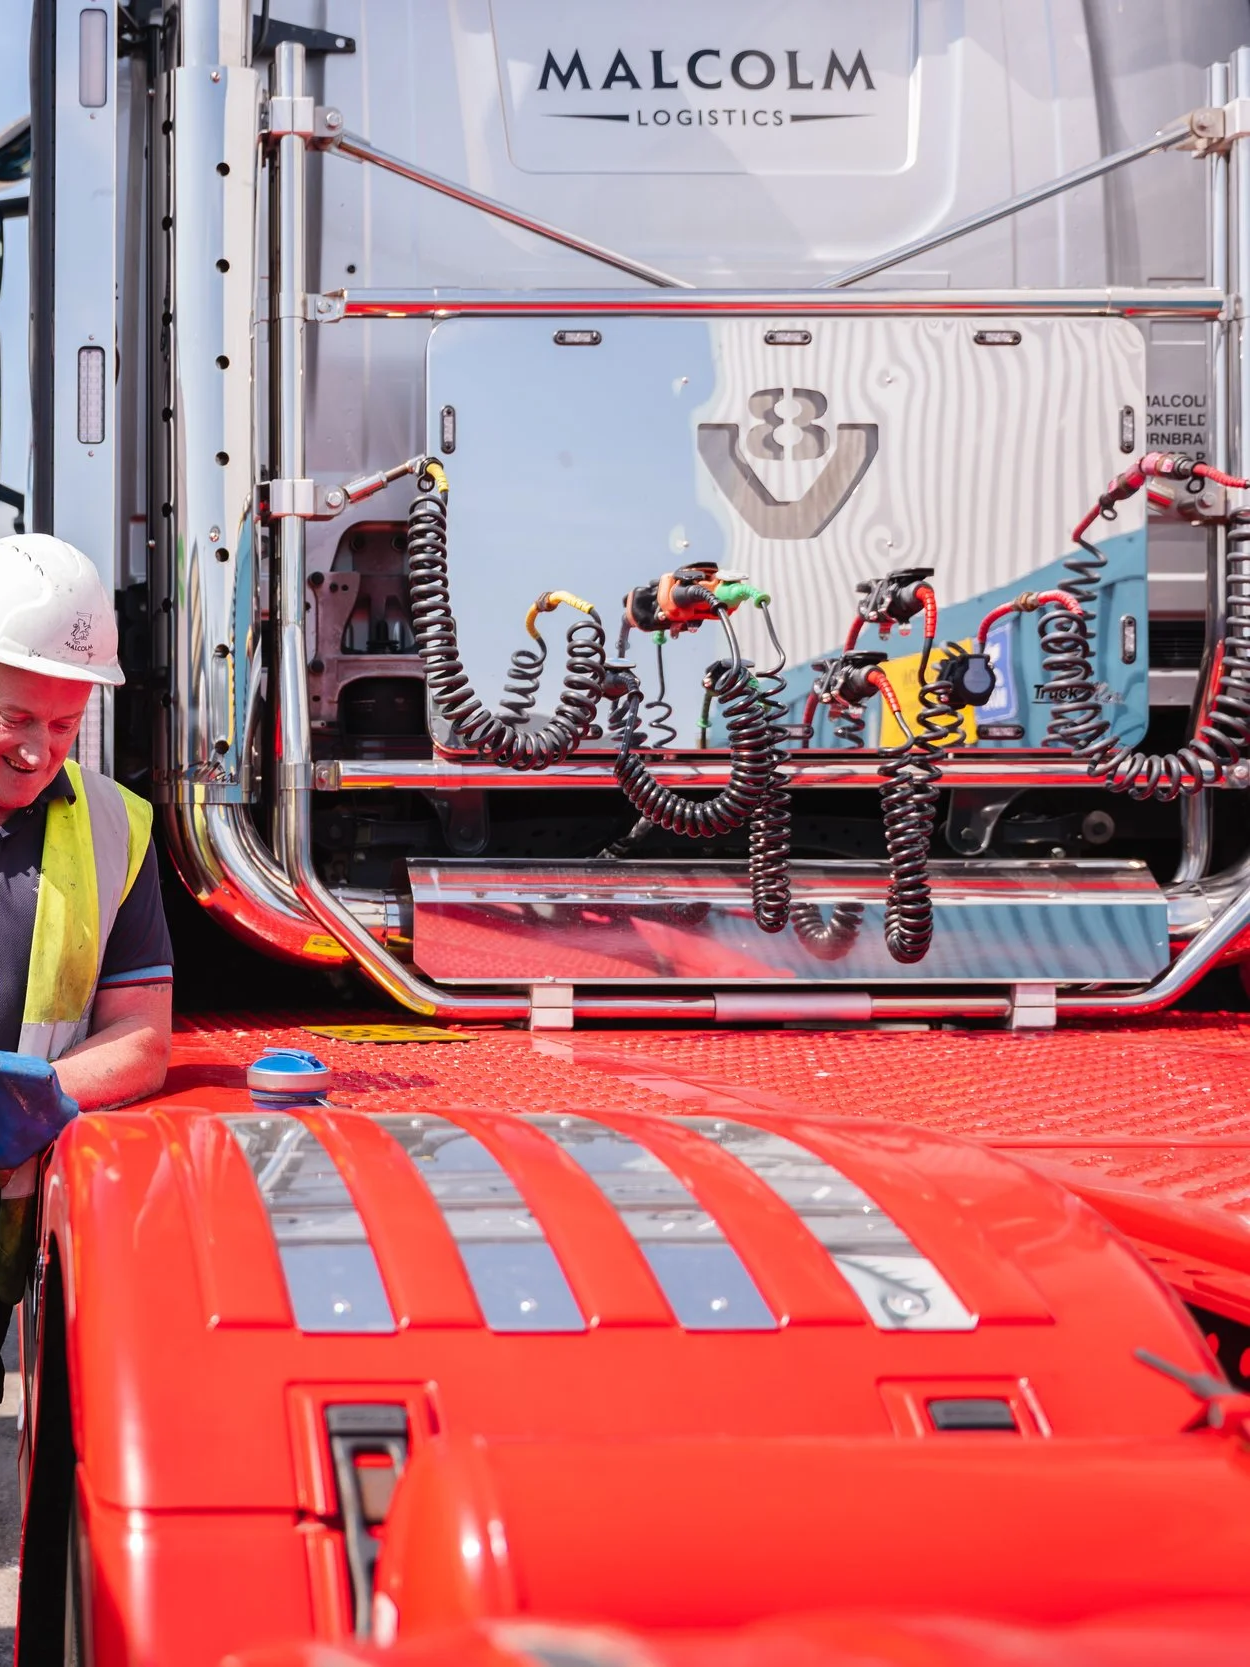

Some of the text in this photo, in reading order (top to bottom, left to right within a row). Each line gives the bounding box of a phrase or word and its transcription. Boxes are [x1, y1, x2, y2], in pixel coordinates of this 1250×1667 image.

[537, 49, 876, 91] MALCOLM
[638, 109, 783, 126] LOGISTICS
[64, 641, 93, 651] MALCOLM
